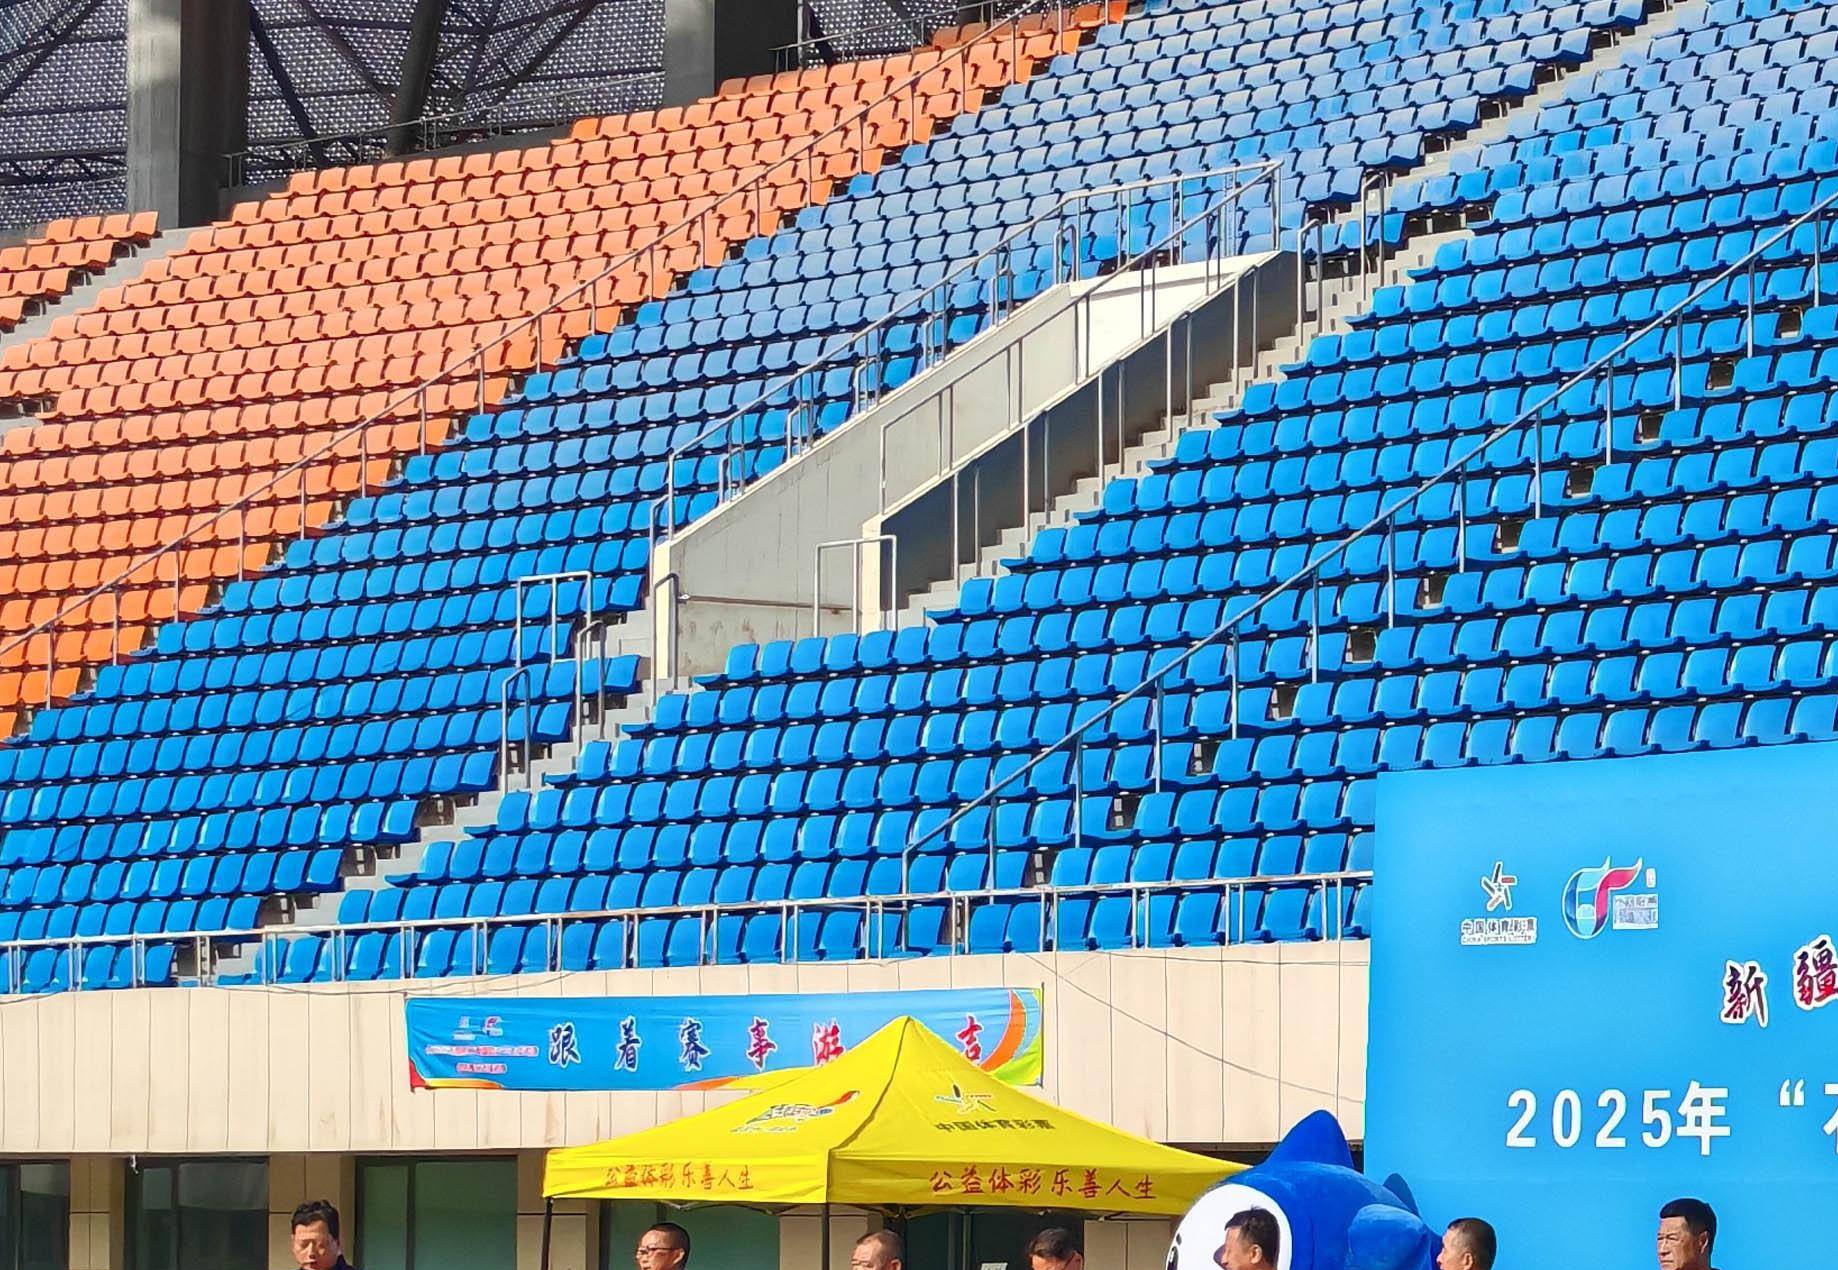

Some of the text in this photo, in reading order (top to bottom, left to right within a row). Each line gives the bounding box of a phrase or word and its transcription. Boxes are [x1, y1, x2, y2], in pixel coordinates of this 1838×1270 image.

[549, 1013, 984, 1072] 跟着赛事游吉
